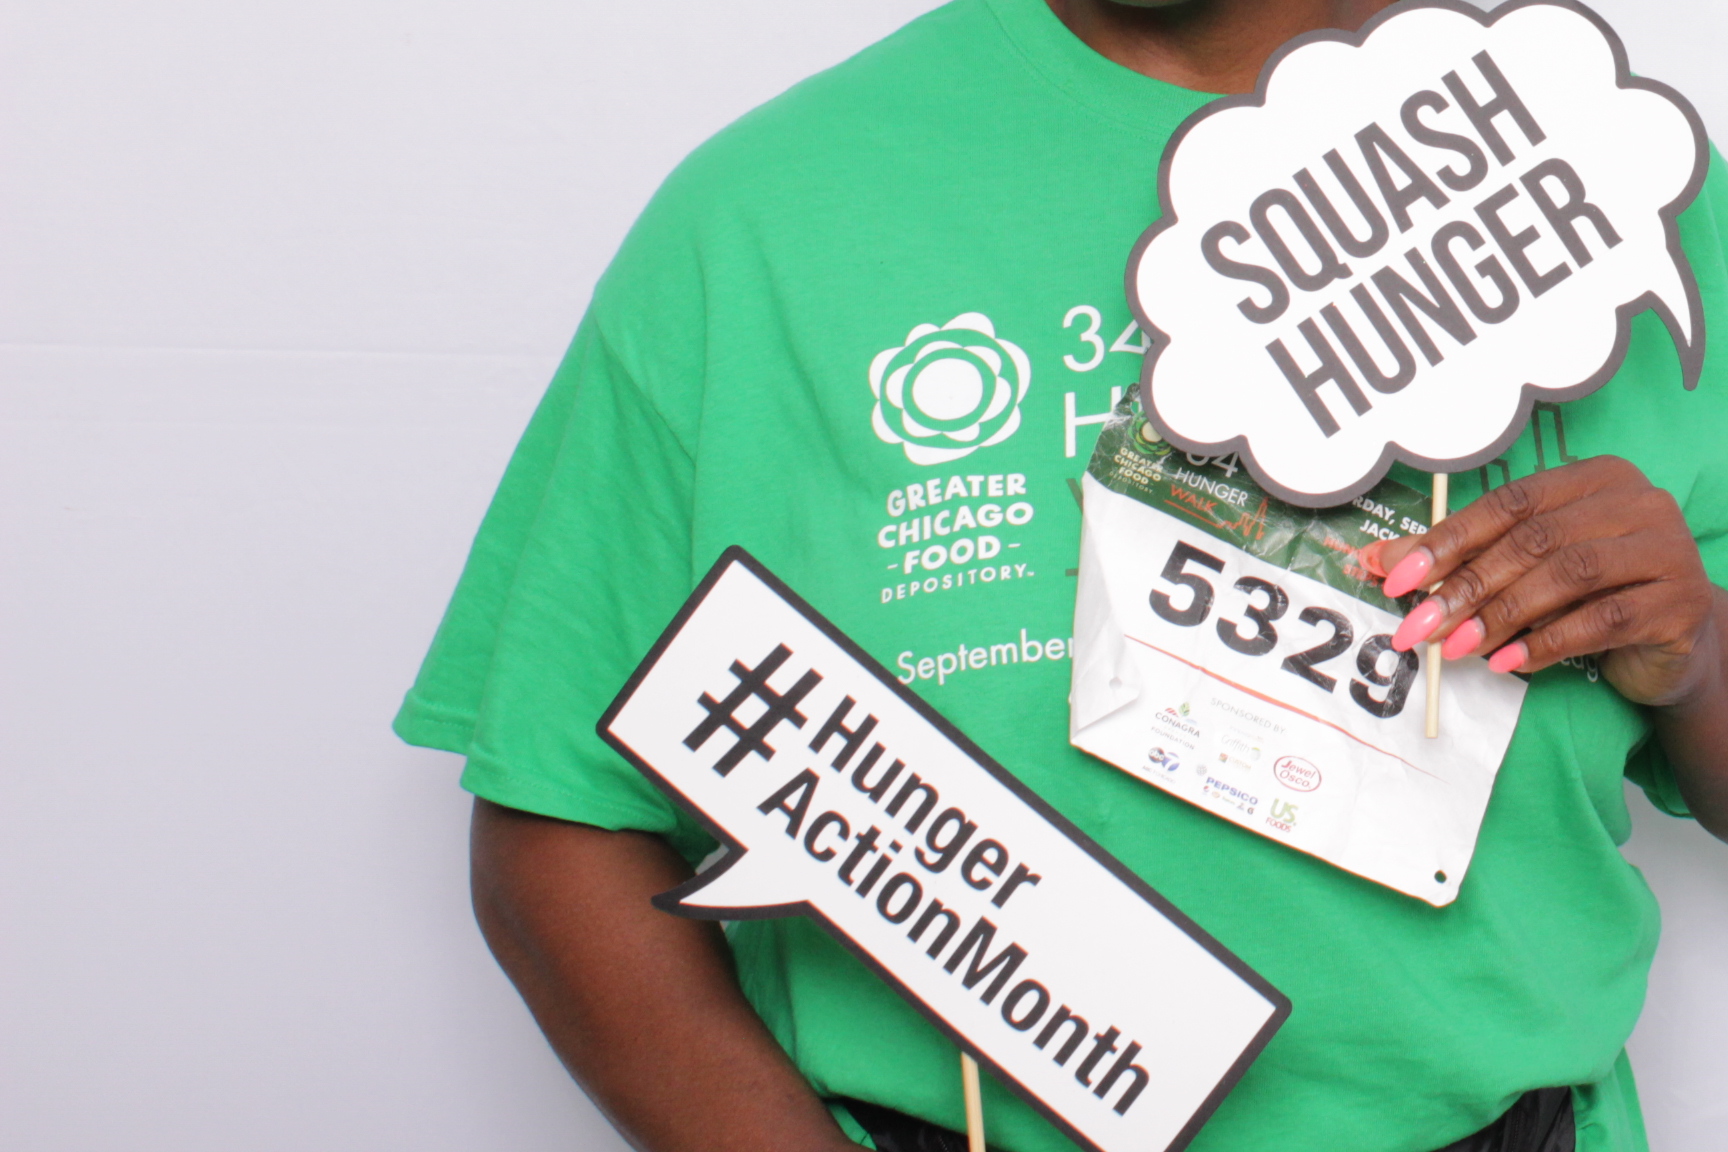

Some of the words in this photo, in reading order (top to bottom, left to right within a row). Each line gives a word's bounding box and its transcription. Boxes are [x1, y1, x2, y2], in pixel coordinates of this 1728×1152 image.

[1201, 49, 1547, 325] SQUASH
[1265, 158, 1623, 438] HUNGER
[1113, 454, 1162, 482] CHICAGO
[1119, 447, 1163, 473] GREATER
[886, 473, 1027, 517] GREATER
[1171, 484, 1218, 512] WALK
[1174, 466, 1249, 507] HUNGER
[877, 501, 1034, 548] CHICAGO
[1352, 495, 1396, 525] RDAY,
[1400, 516, 1429, 535] SEP
[1149, 540, 1419, 718] 5329
[1155, 711, 1200, 738] CONAGRA
[1210, 697, 1272, 729] SPONSORED
[1151, 726, 1195, 750] FOUNDATION
[1221, 734, 1250, 753] Griffith
[1281, 760, 1317, 779] Jewel
[1206, 776, 1258, 806] PEPSICO
[1265, 816, 1292, 833] FOODS
[756, 767, 1151, 1116] ActionMonth
